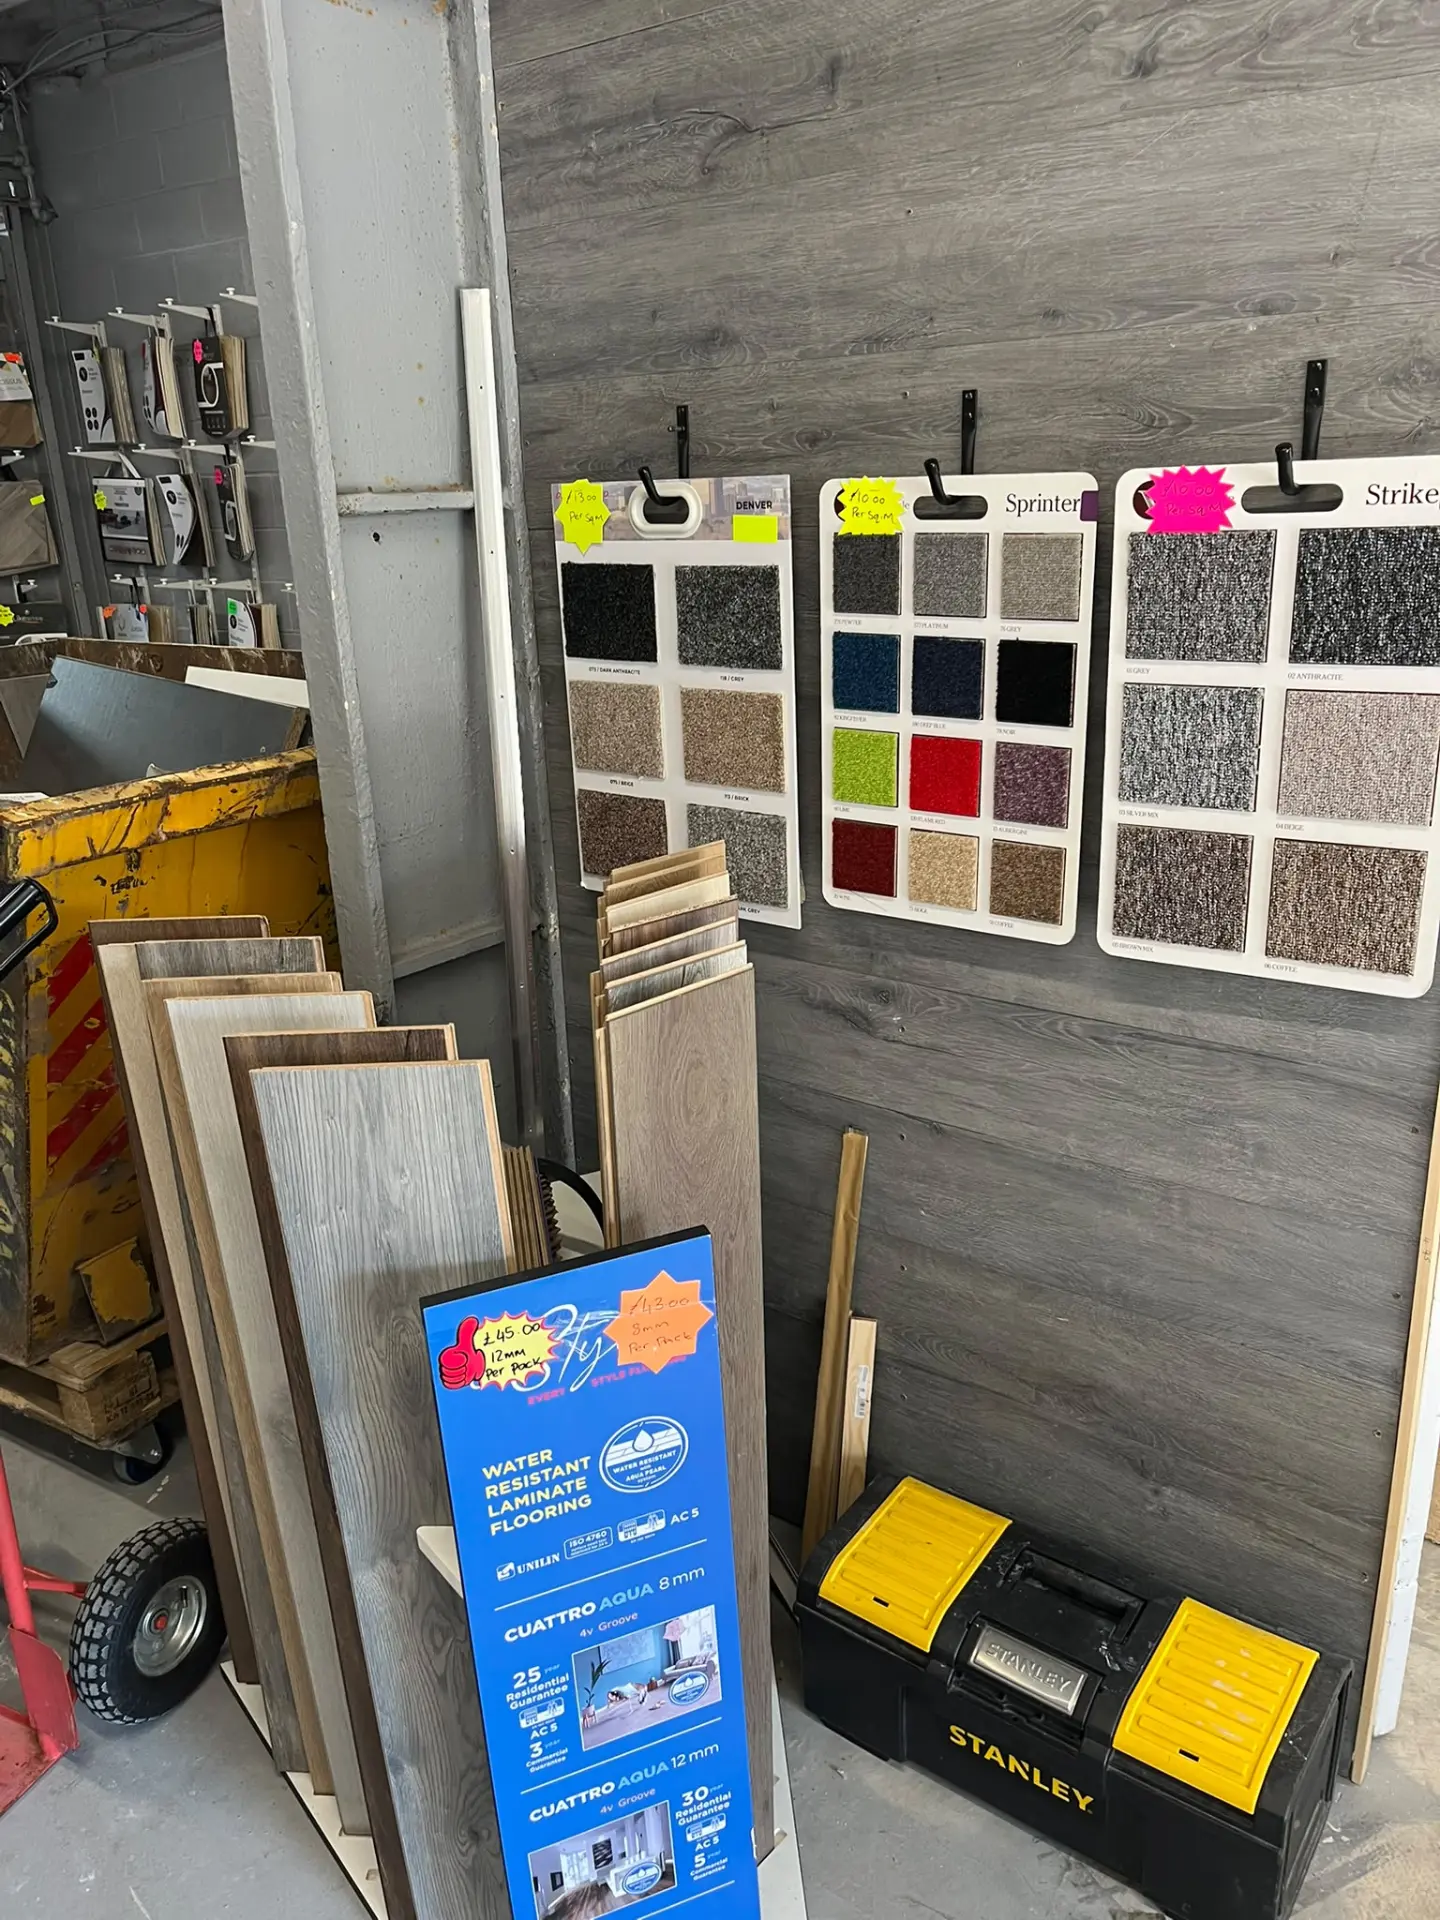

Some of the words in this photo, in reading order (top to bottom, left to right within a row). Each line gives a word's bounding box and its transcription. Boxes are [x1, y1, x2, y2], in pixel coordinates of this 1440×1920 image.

[736, 500, 772, 510] DENVER
[1006, 493, 1080, 517] Sprinter
[1366, 483, 1440, 510] Strike
[491, 1348, 526, 1363] 12mm
[628, 1341, 649, 1355] Per
[485, 1366, 505, 1381] Per
[482, 1448, 554, 1480] WATER
[612, 1460, 638, 1474] WATER
[638, 1450, 677, 1466] RESISTANT
[644, 1465, 667, 1478] PEARL
[485, 1455, 592, 1500] RESISTANT
[488, 1476, 588, 1518] LAMINATE
[490, 1494, 592, 1536] FLOORING
[670, 1510, 689, 1526] AC
[692, 1507, 700, 1518] 5
[569, 1538, 585, 1548] ISO
[517, 1552, 560, 1574] UNILIN
[504, 1602, 596, 1642] CUATTRO
[600, 1583, 654, 1612] AQUA
[580, 1626, 594, 1638] 4v
[598, 1612, 638, 1632] Groove
[513, 1666, 542, 1689] 25
[985, 1643, 1072, 1692] STANLEY
[506, 1672, 570, 1702] Residential
[510, 1684, 568, 1710] Guarantee
[530, 1726, 549, 1740] AC
[550, 1722, 558, 1733] 5
[526, 1747, 568, 1768] Commercial
[530, 1740, 543, 1759] 3
[530, 1756, 566, 1774] Guarantee
[950, 1724, 1094, 1812] STANLEY
[528, 1781, 616, 1822] CUATTRO
[618, 1761, 670, 1790] AQUA
[618, 1788, 656, 1808] Groove
[682, 1786, 709, 1807] 30
[675, 1791, 732, 1820] Residential
[678, 1802, 730, 1826] Guarantee
[695, 1841, 712, 1852] AC
[712, 1835, 720, 1844] 5
[694, 1852, 706, 1868] 5
